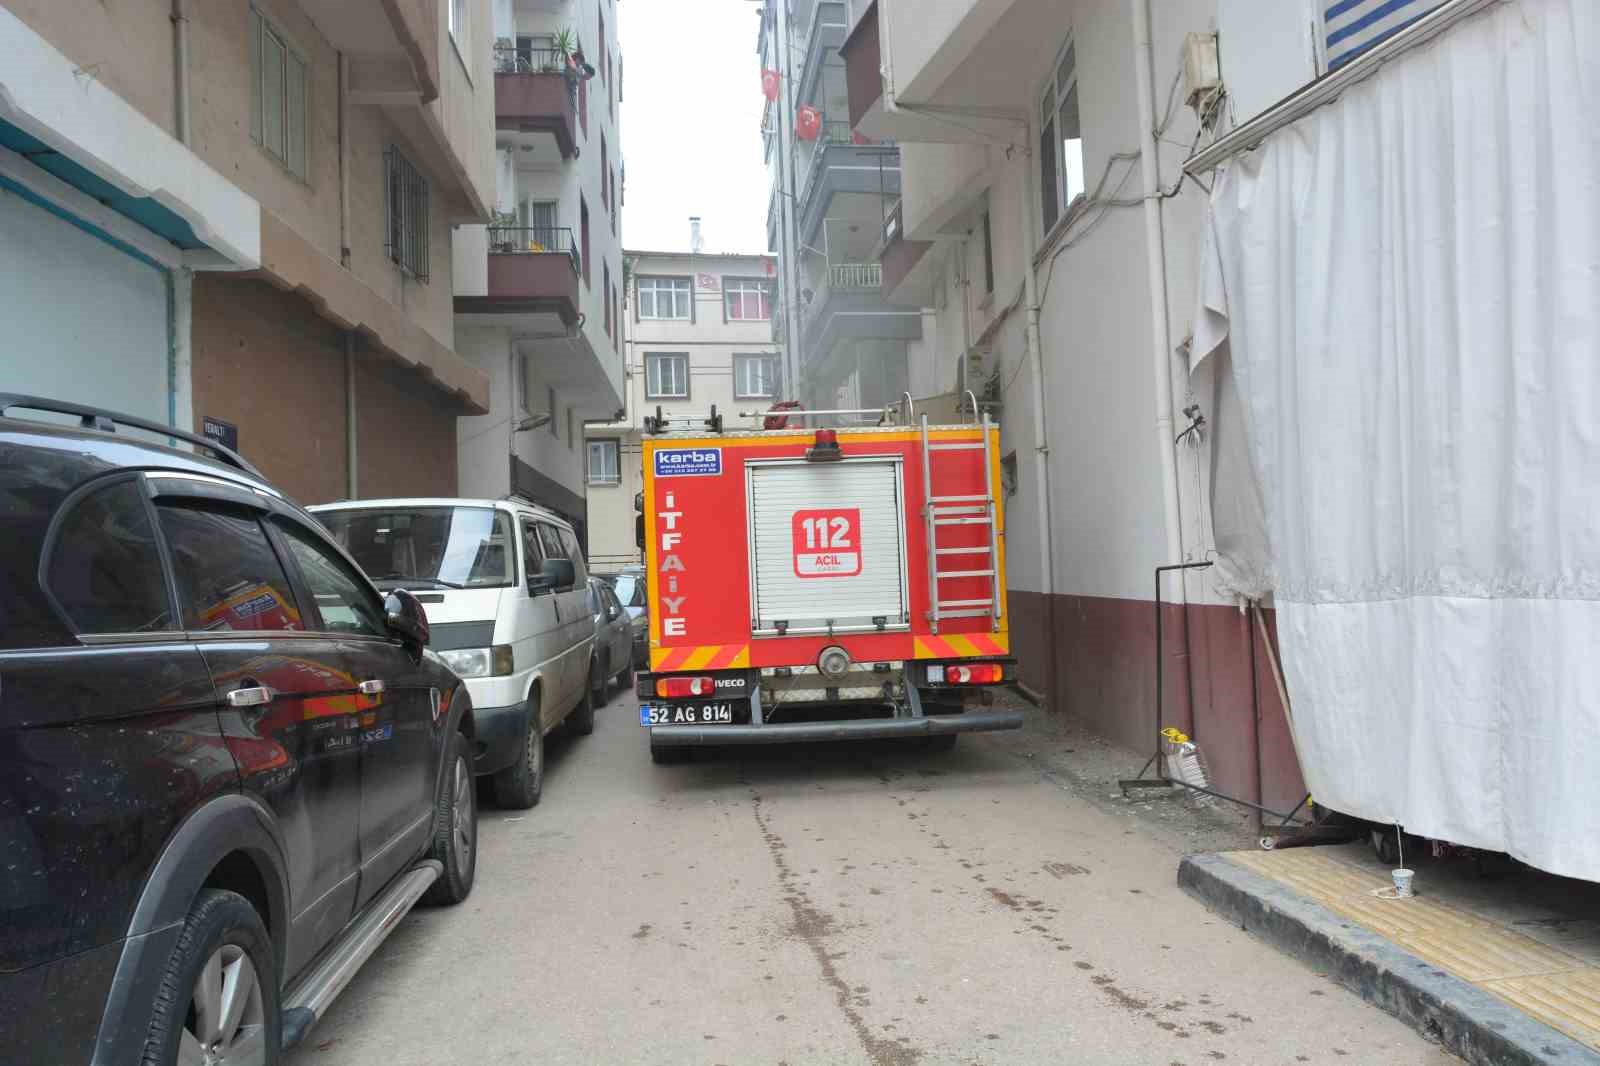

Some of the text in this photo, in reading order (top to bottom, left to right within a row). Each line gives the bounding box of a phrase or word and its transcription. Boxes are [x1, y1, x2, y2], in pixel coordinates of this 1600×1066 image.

[659, 451, 716, 464] karba
[802, 516, 851, 548] 112
[715, 679, 745, 688] IVECO
[649, 708, 669, 723] 52
[674, 706, 695, 722] AG
[702, 704, 729, 721] 814
